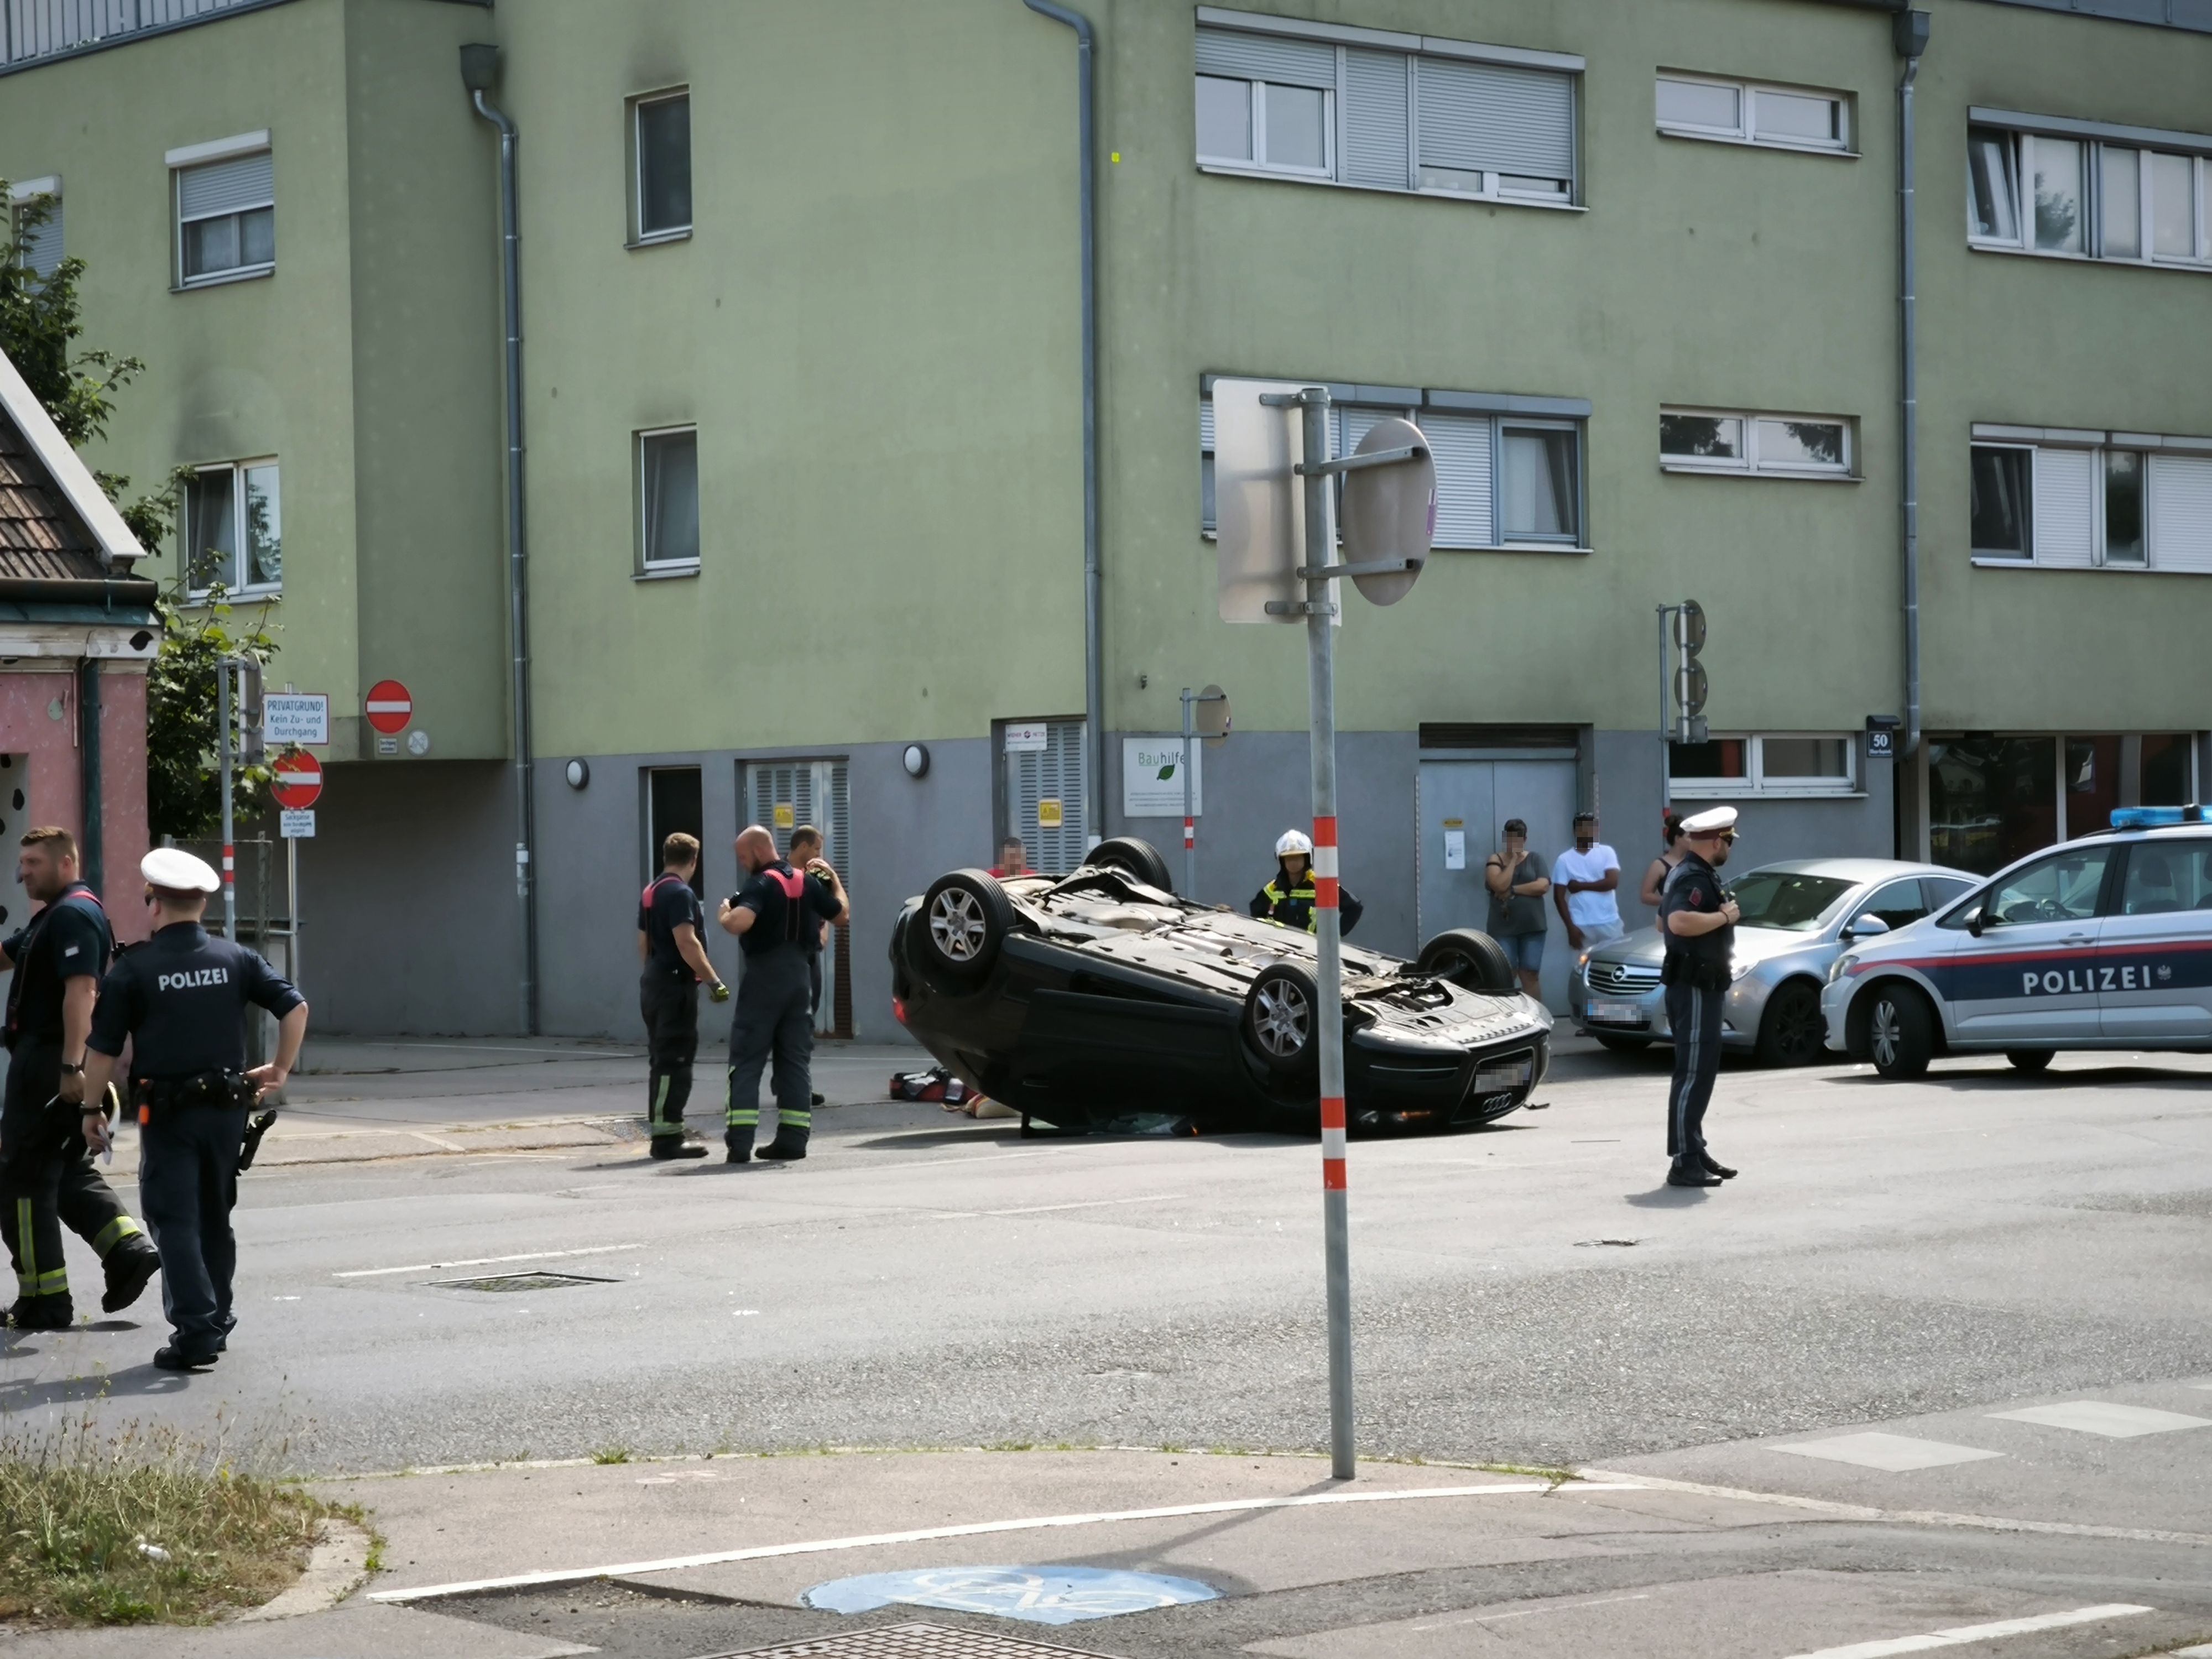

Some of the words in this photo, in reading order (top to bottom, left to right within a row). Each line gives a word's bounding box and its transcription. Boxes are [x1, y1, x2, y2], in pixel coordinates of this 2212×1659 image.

[268, 700, 324, 712] PRIVATGRUND!
[270, 714, 288, 723] Kein
[290, 715, 304, 723] Zu-
[306, 716, 321, 724] und
[274, 727, 317, 738] Durchgang
[1874, 734, 1888, 747] 50
[1139, 752, 1185, 765] Bauhilfe
[158, 967, 228, 992] POLIZEI
[2023, 965, 2151, 995] POLIZEI
